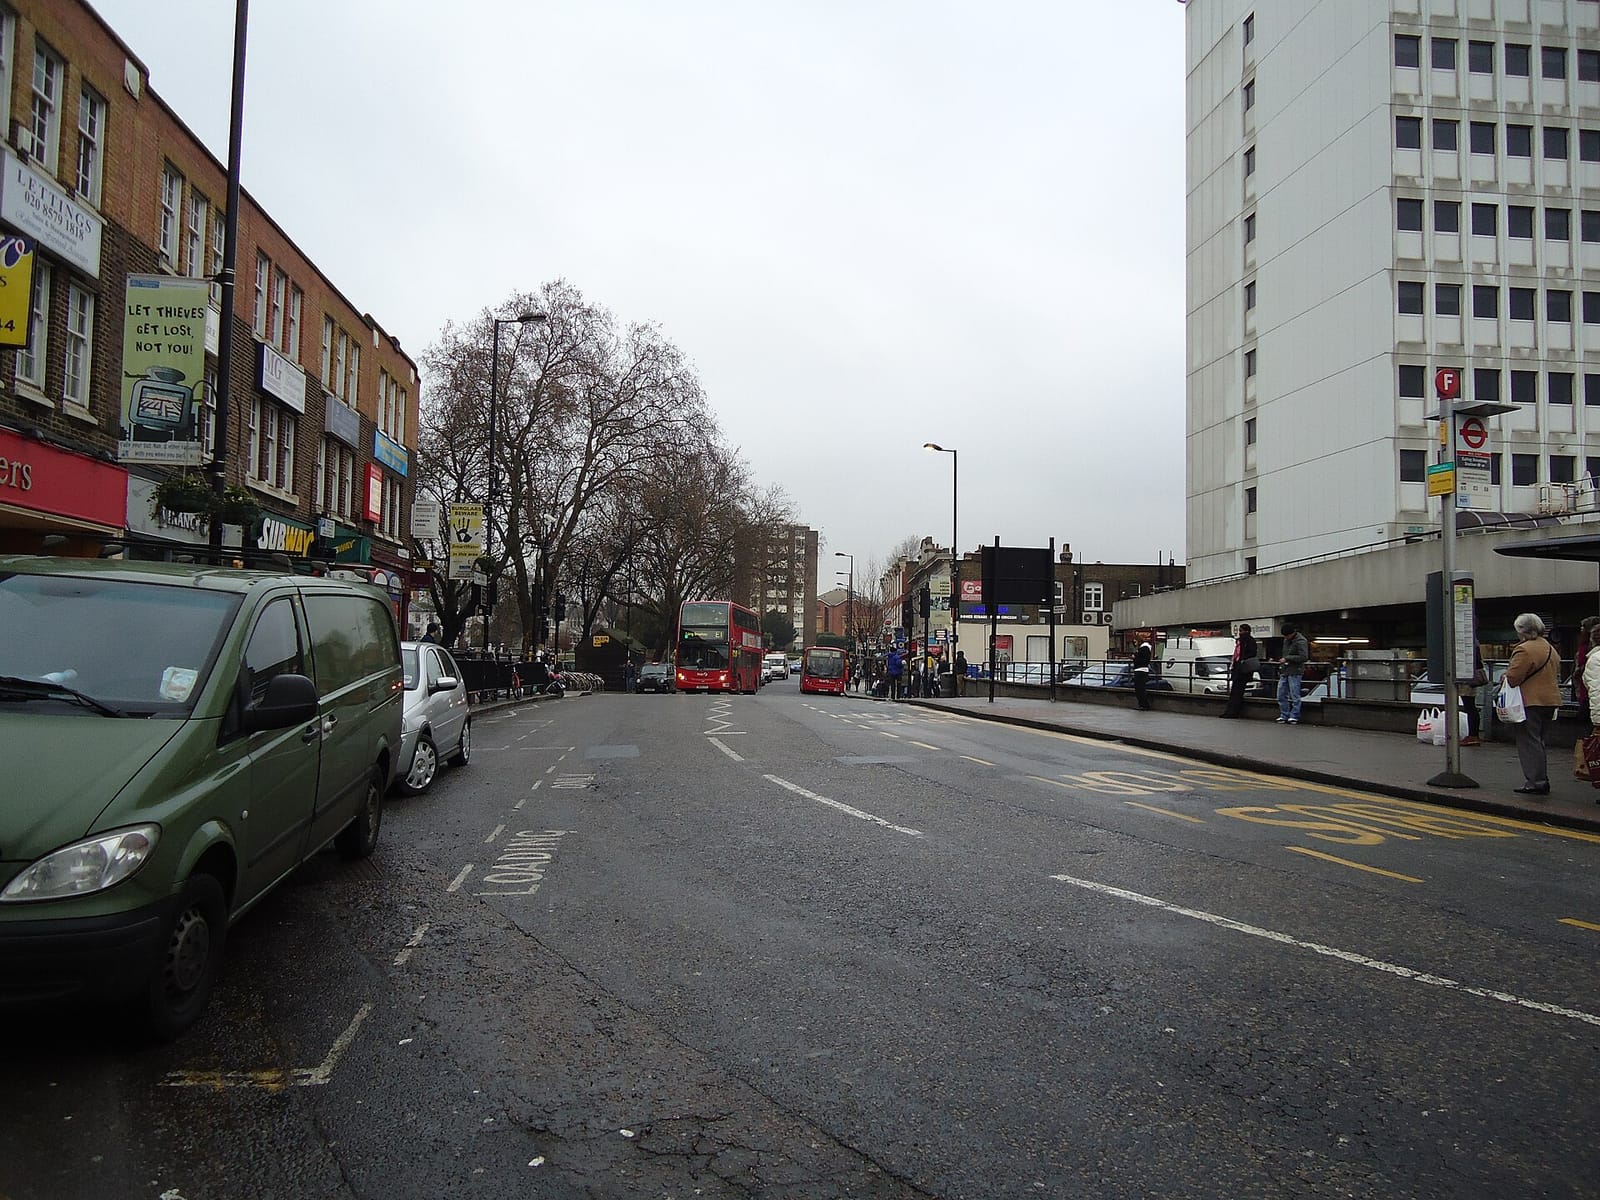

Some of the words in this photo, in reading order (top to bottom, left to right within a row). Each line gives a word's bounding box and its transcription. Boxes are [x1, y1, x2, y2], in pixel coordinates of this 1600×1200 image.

[17, 169, 92, 233] LETTINGS
[25, 191, 40, 210] 020
[42, 203, 63, 226] 8579
[65, 220, 84, 241] 1818
[128, 304, 151, 317] LET
[156, 305, 205, 319] THIEVES
[136, 322, 159, 335] GET
[135, 341, 162, 353] NOT
[167, 343, 193, 354] YOU!
[1442, 373, 1454, 391] F
[257, 517, 315, 557] SUBWAY
[472, 830, 576, 896] LOADING
